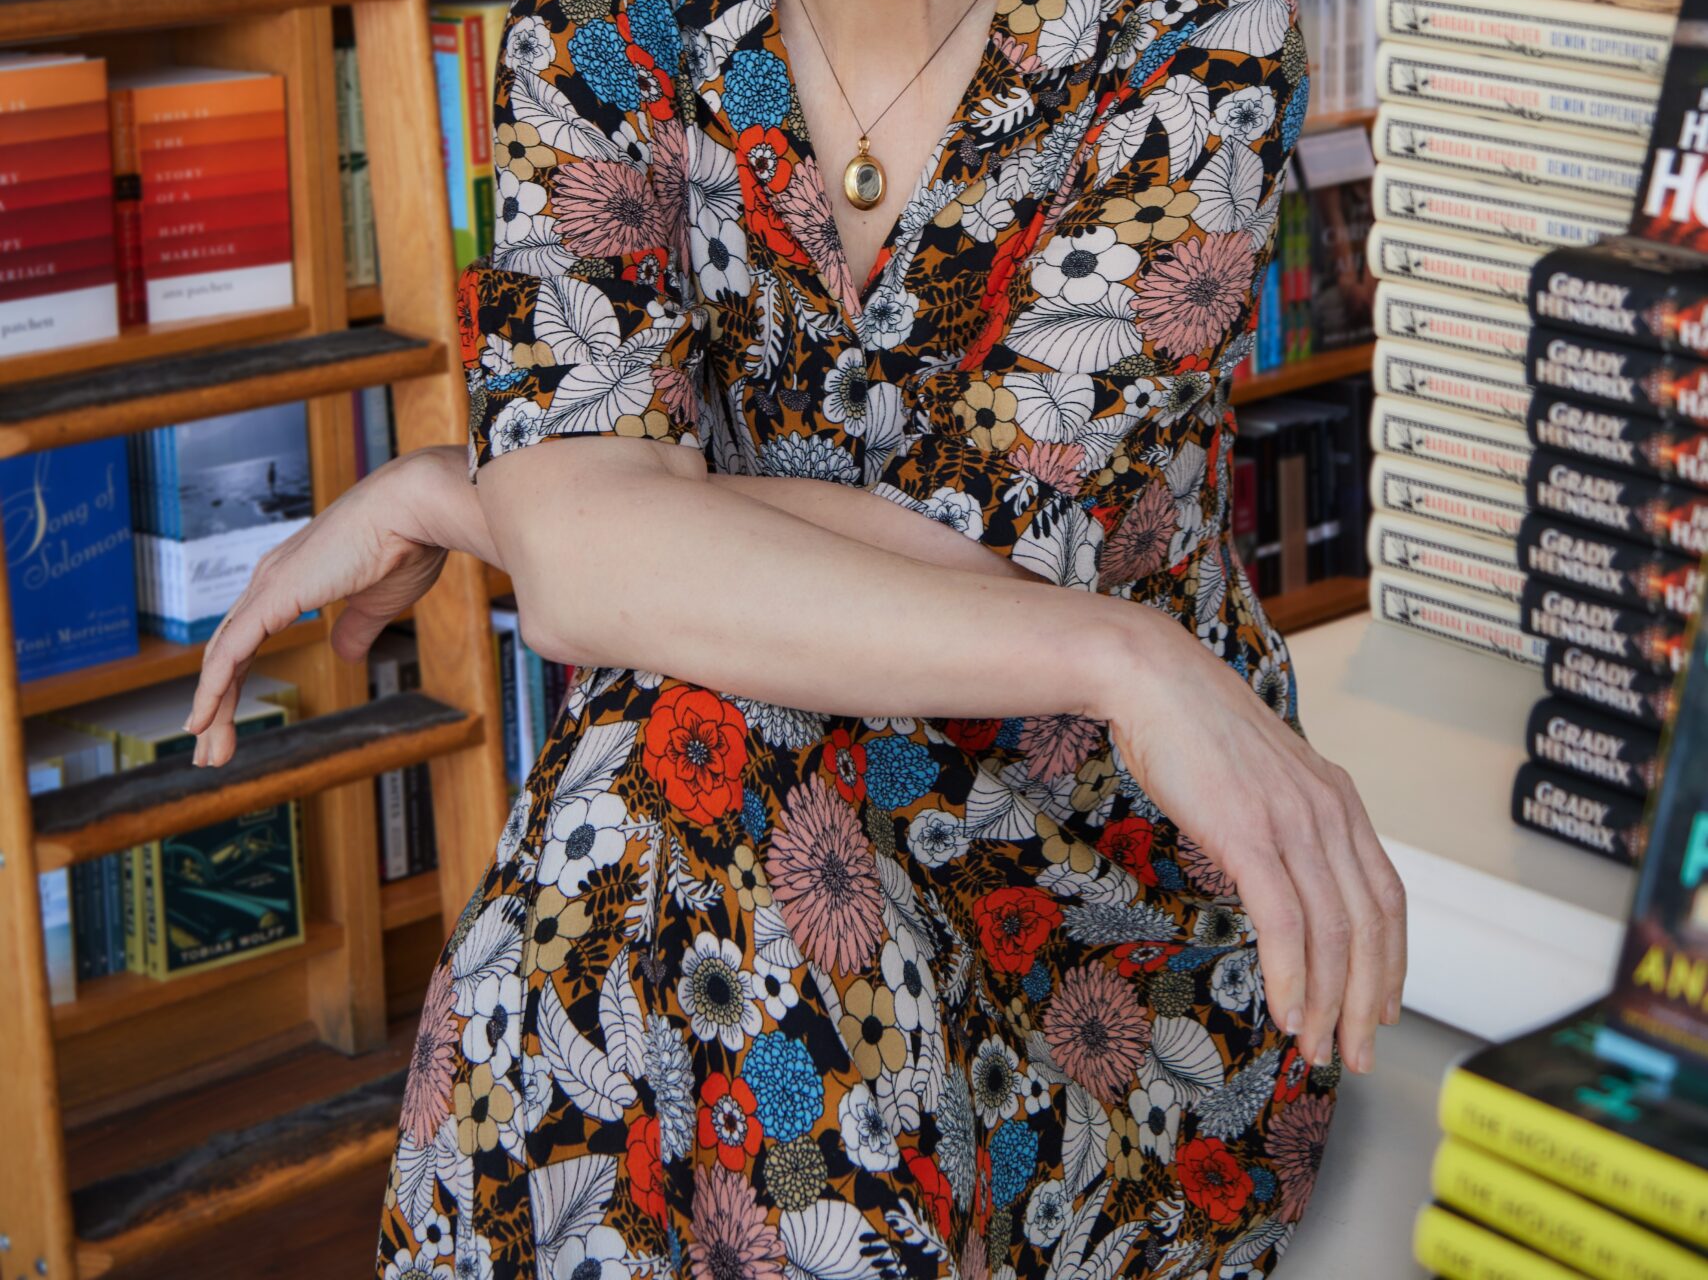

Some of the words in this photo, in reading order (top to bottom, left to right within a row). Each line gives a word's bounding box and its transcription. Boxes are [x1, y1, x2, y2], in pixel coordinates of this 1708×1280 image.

[1430, 13, 1475, 34] BARBARA
[1479, 21, 1541, 46] KINGSOLVER
[1551, 30, 1587, 50] DEMON
[1590, 35, 1660, 63] COPPERHEAD
[1430, 74, 1475, 95] BARBARA
[1478, 82, 1540, 108] KINGSOLVER
[1550, 93, 1587, 112] DEMON
[154, 137, 184, 150] THE
[1426, 137, 1472, 159] BARBARA
[1476, 145, 1537, 171] KINGSOLVER
[1547, 158, 1583, 179] DEMON
[155, 167, 203, 184] STORY
[156, 194, 175, 204] OF
[181, 191, 191, 202] A
[159, 222, 206, 238] HAPPY
[1426, 196, 1472, 219] BARBARA
[1475, 204, 1537, 231] KINGSOLVER
[1546, 220, 1581, 241] DEMON
[160, 242, 237, 263] MARRIAGE
[1422, 256, 1468, 280] BARBARA
[1548, 272, 1629, 308] GRADY
[1428, 318, 1473, 342] BARBARA
[1536, 290, 1637, 334] HENDRIX
[1547, 339, 1627, 373] GRADY
[1427, 376, 1472, 400] BARBARA
[1535, 358, 1635, 402] HENDRIX
[1548, 401, 1627, 435] GRADY
[1424, 436, 1469, 461] BARBARA
[1536, 420, 1635, 465] HENDRIX
[95, 463, 115, 511] of
[1548, 464, 1624, 501] GRADY
[1424, 494, 1469, 518] BARBARA
[1537, 482, 1631, 529] HENDRIX
[23, 525, 131, 591] Solomon
[1540, 528, 1617, 567] GRADY
[1420, 550, 1464, 576] BARBARA
[1468, 561, 1524, 592] KINGSOLVER
[1529, 545, 1625, 595] HENDRIX
[1421, 606, 1465, 630] BARBARA
[1466, 616, 1523, 651] KINGSOLVER
[1542, 592, 1620, 630] GRADY
[15, 636, 51, 656] Toni
[57, 618, 130, 643] Morrison
[1531, 610, 1628, 657] HENDRIX
[1563, 647, 1637, 688] GRADY
[1552, 663, 1644, 716] HENDRIX
[1547, 717, 1625, 757] GRADY
[1535, 734, 1631, 785] HENDRIX
[1535, 781, 1611, 824] GRADY
[1522, 798, 1616, 853] HENDRIX
[179, 940, 234, 963] TOBIAS
[239, 925, 286, 947] WOLFF
